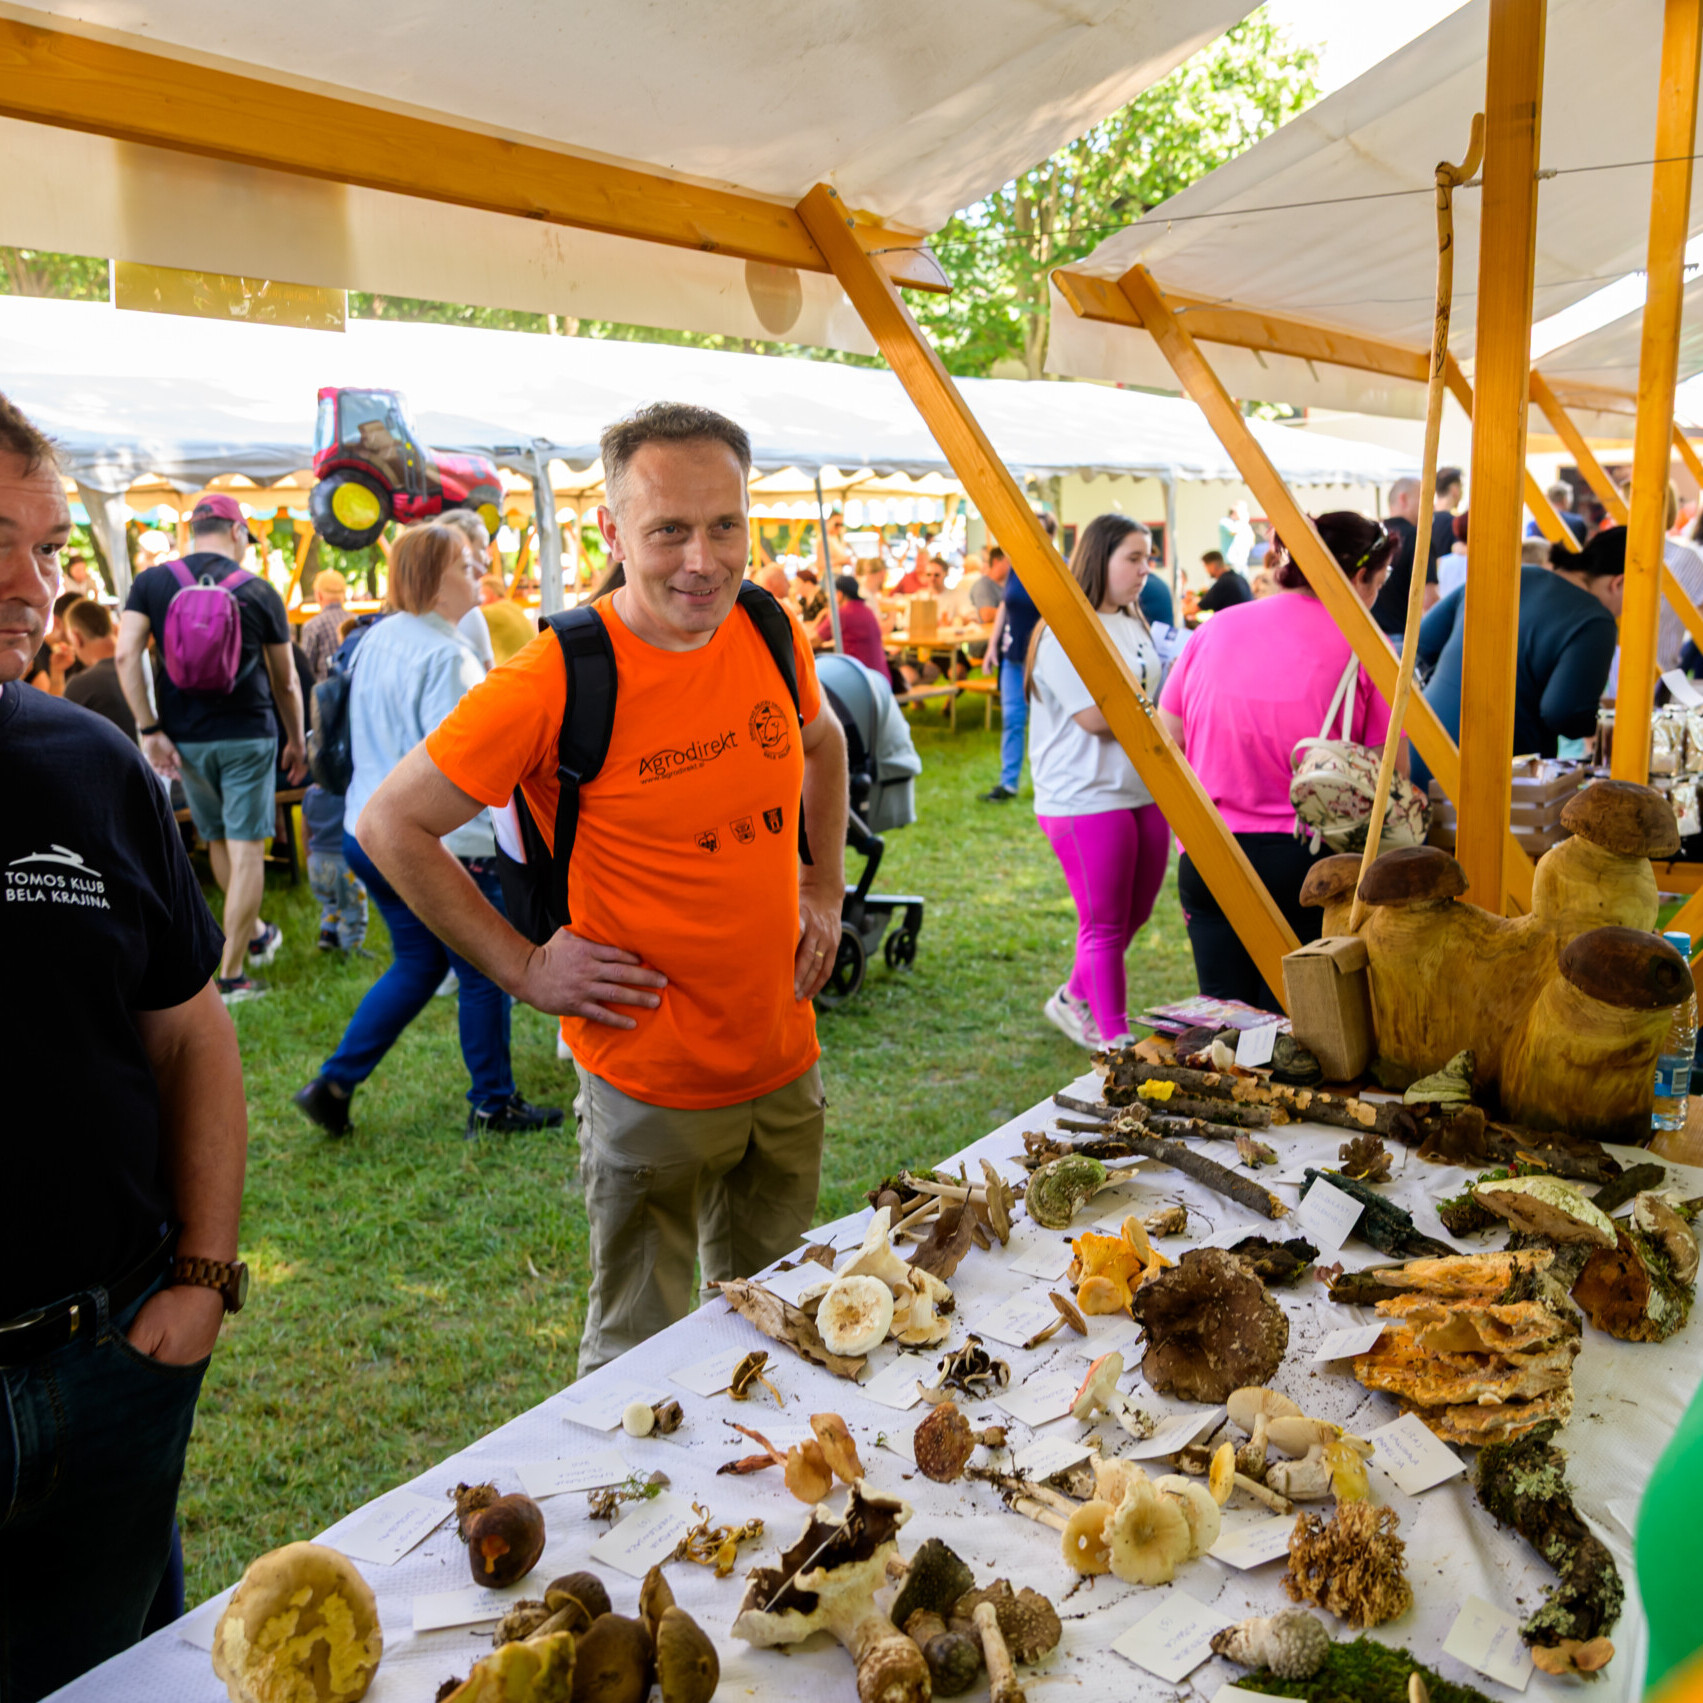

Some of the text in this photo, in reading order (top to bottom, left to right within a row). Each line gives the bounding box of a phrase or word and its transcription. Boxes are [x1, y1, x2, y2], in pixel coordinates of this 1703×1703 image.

[638, 730, 738, 776] Agrodirekt
[5, 871, 105, 894] TOMOS KLUB
[5, 888, 111, 910] BELA KRAJINA
